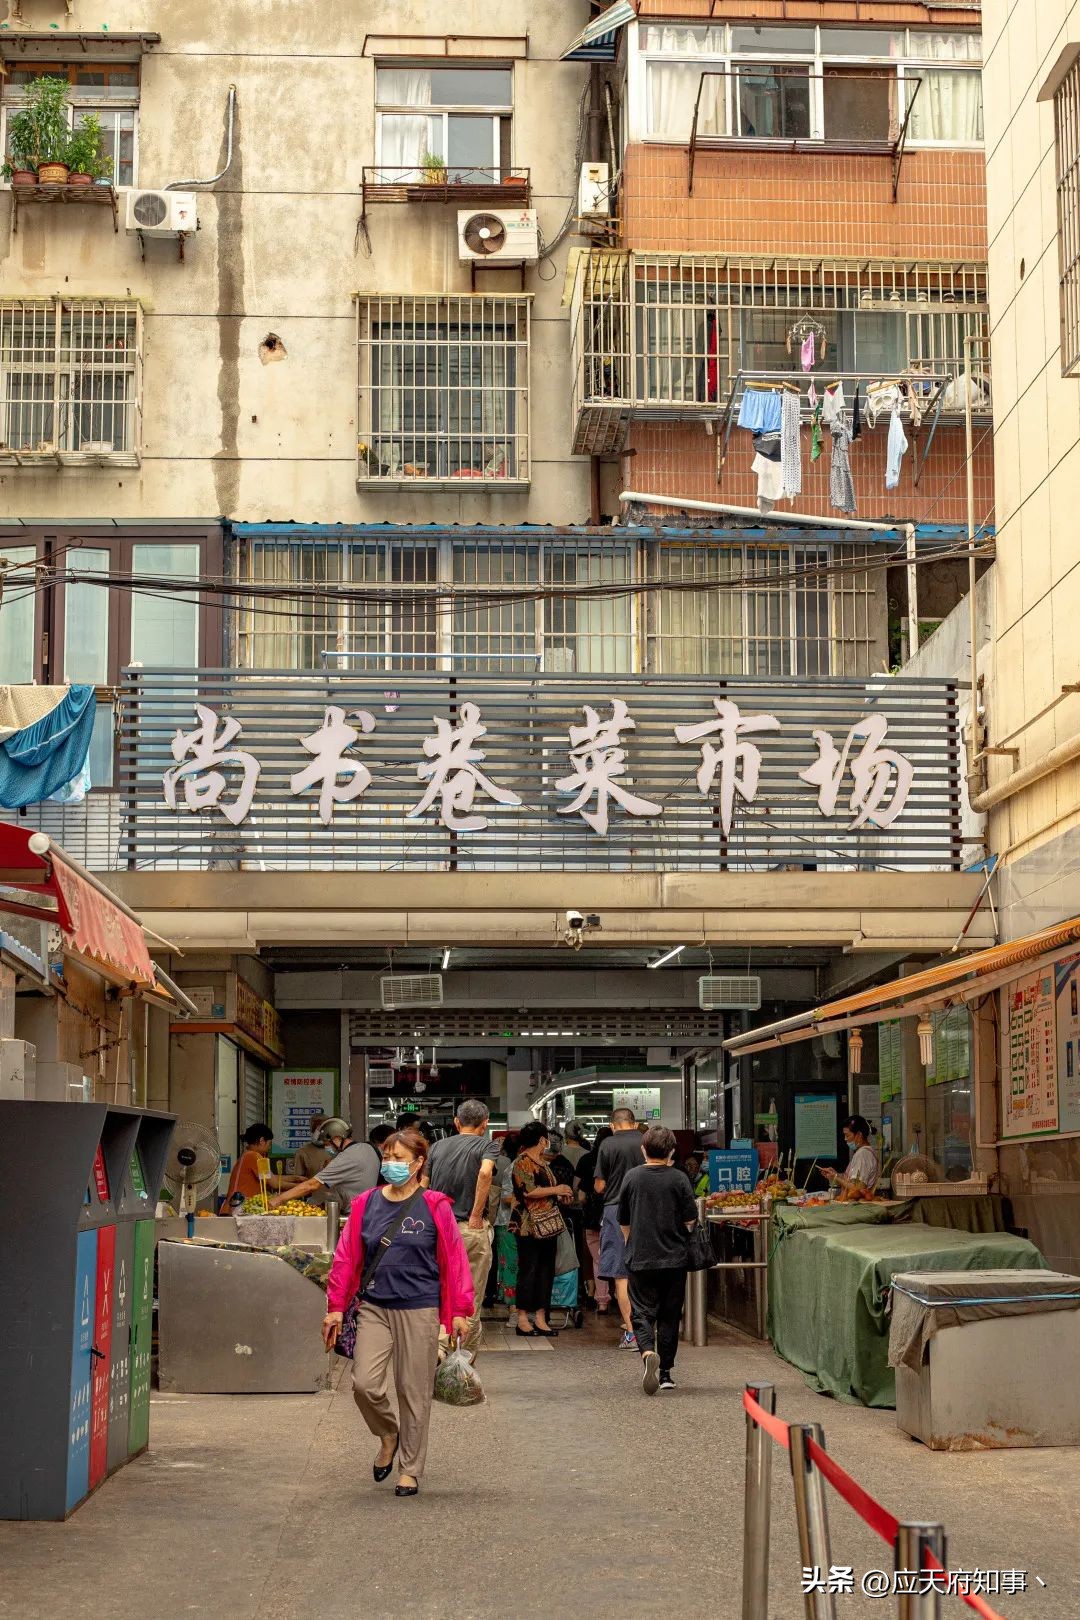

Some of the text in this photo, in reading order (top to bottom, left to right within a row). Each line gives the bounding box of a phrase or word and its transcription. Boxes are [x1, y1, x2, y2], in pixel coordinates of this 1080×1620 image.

[163, 698, 915, 836] 尚书巷菜市场
[718, 1166, 752, 1182] 口腔
